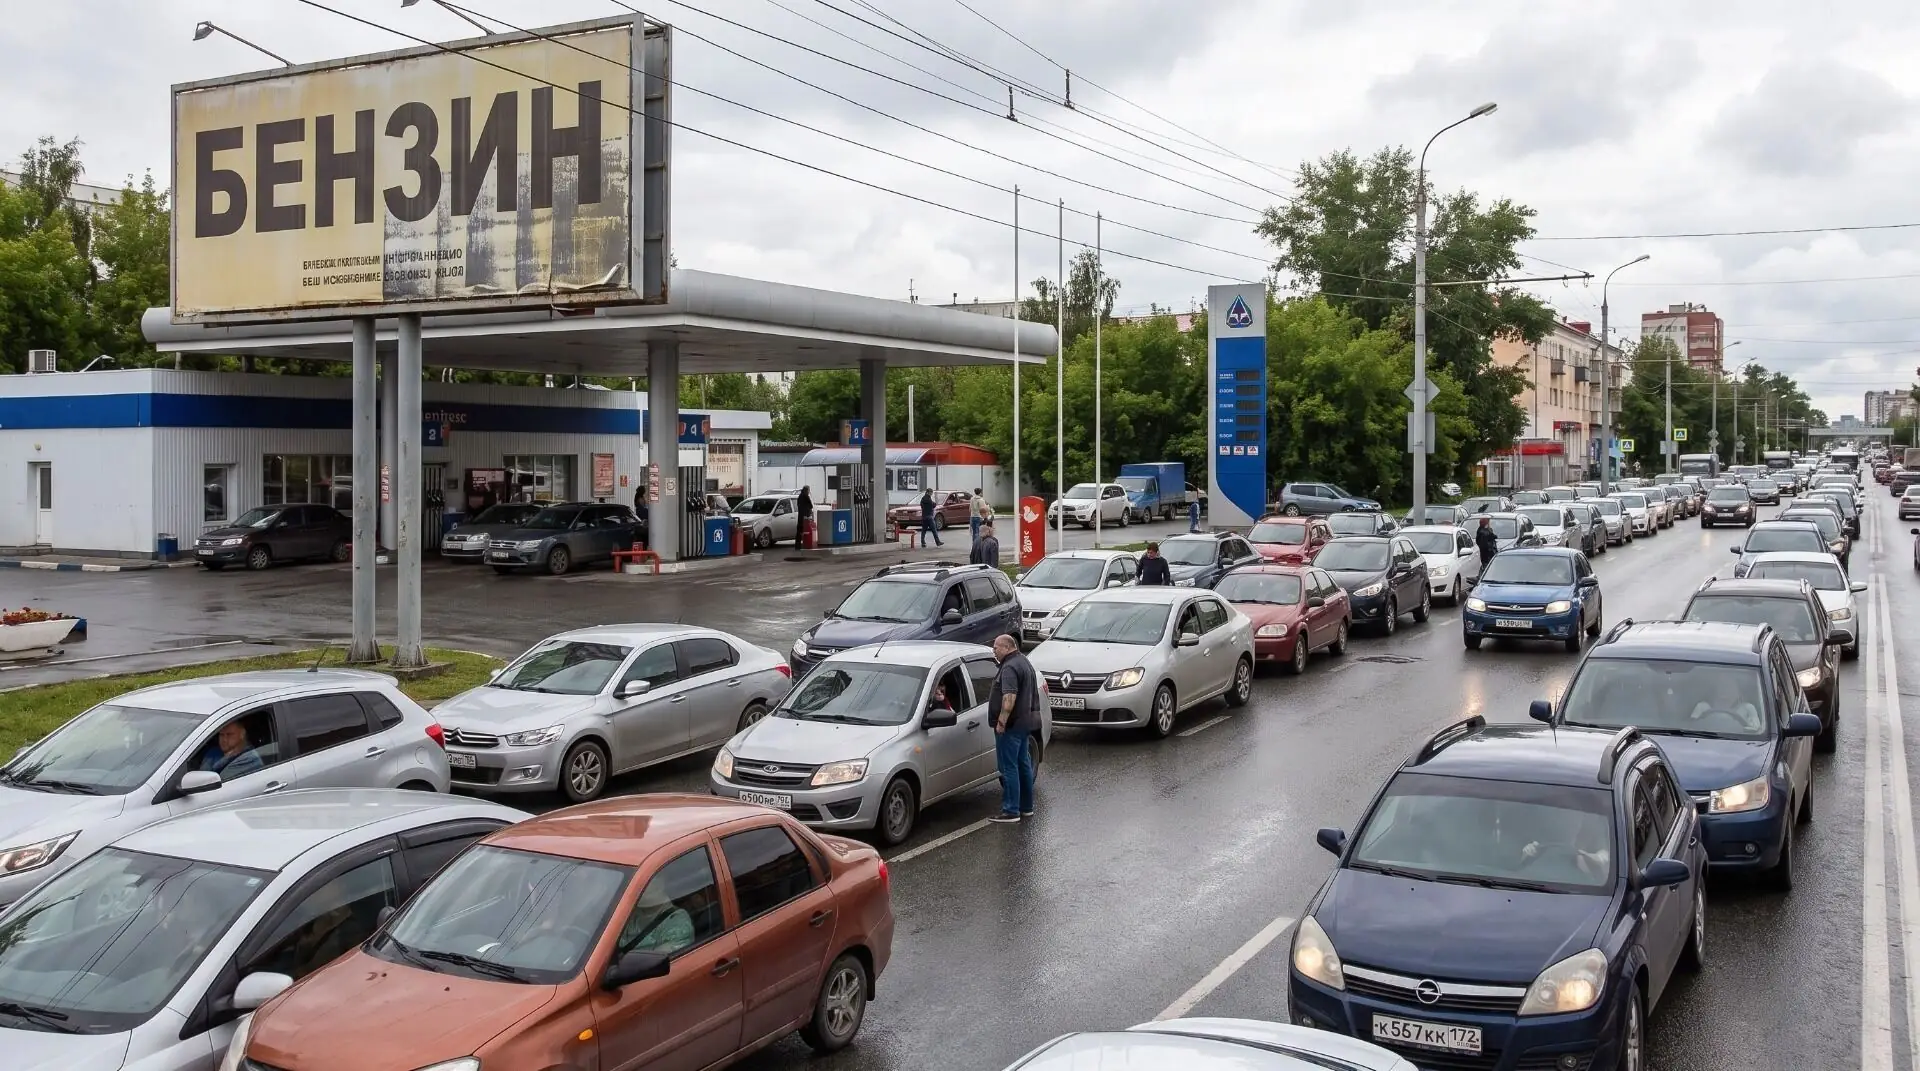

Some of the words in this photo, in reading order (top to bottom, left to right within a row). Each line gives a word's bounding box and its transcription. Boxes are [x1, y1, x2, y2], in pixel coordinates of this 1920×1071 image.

[195, 80, 602, 238] БЕНЗИН
[428, 428, 436, 441] 2
[1450, 1027, 1477, 1043] 172
